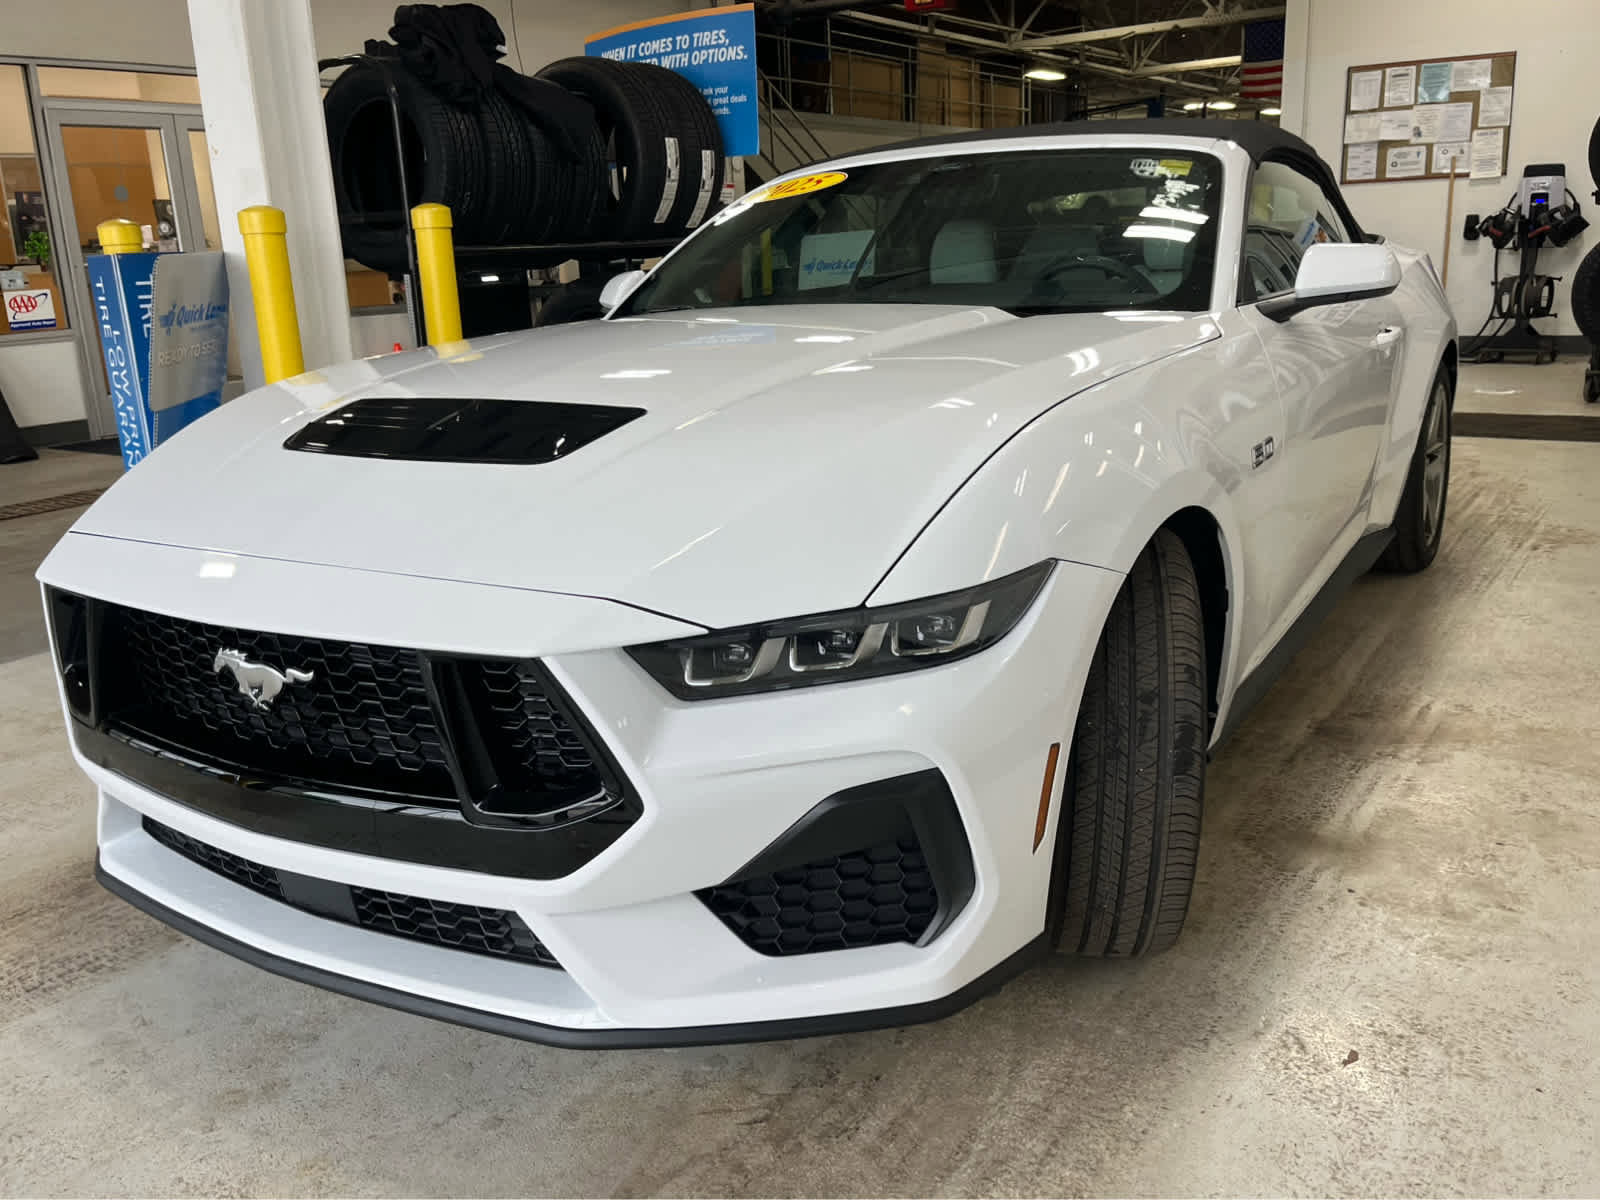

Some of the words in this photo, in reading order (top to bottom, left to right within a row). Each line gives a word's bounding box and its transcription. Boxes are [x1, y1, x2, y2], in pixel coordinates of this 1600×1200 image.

[627, 44, 637, 59] IT
[638, 37, 673, 57] COMES
[675, 34, 690, 50] TO
[693, 29, 730, 47] TIRES,
[660, 53, 689, 69] WITH
[692, 45, 748, 66] OPTIONS.
[712, 96, 729, 107] great
[730, 94, 748, 105] deals
[714, 86, 729, 97] your
[9, 295, 38, 313] AAA
[176, 304, 205, 328] Quick
[96, 276, 112, 337] TIRE
[108, 347, 137, 468] GUARAN
[112, 330, 132, 397] LOW
[126, 406, 144, 464] PRIC
